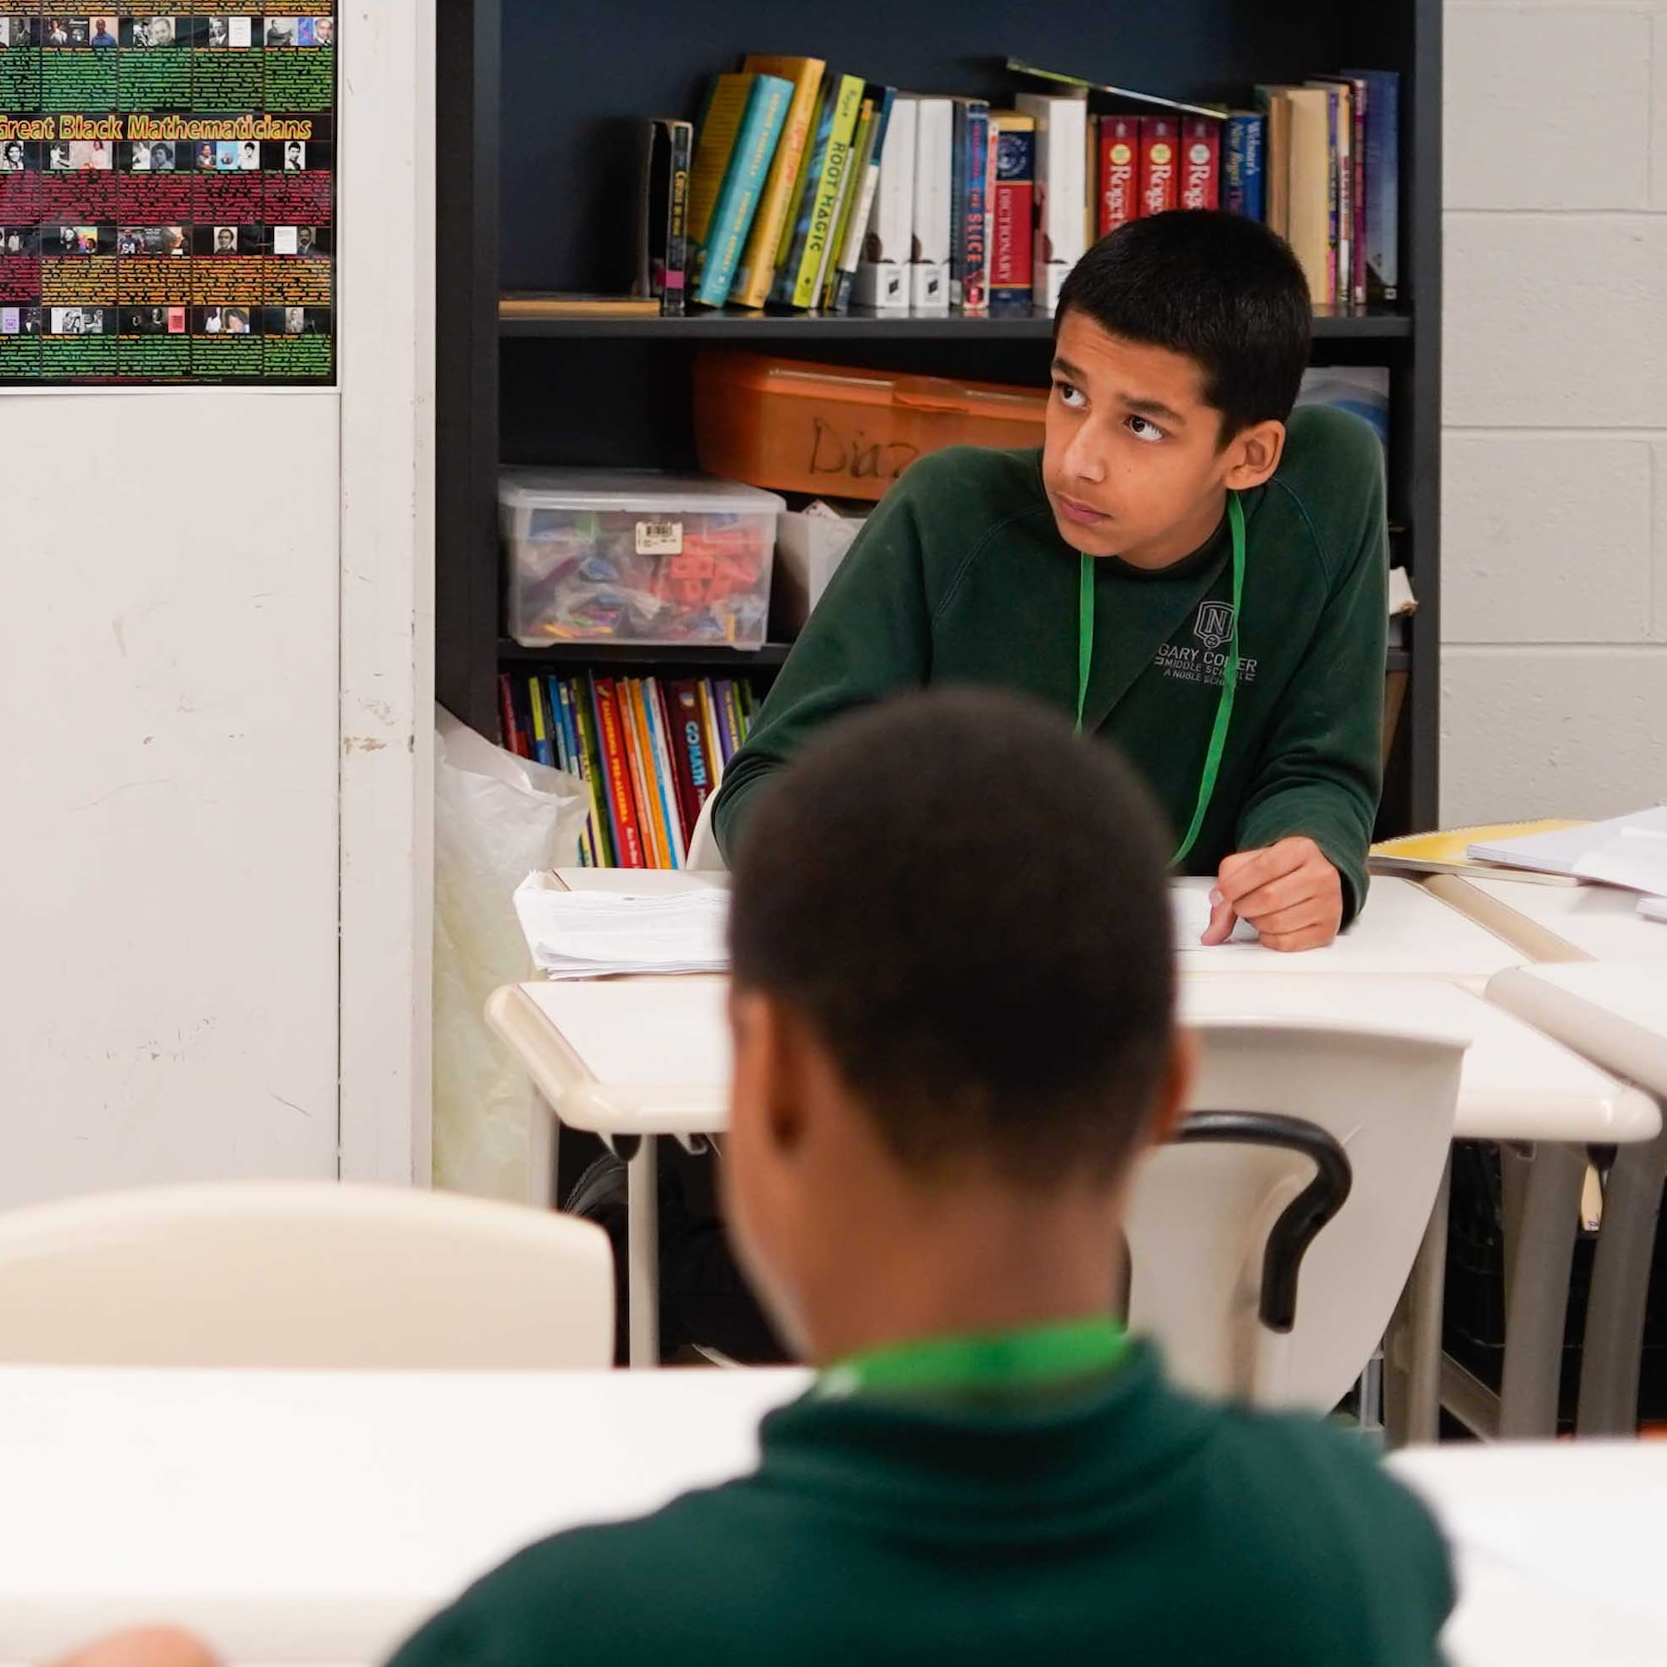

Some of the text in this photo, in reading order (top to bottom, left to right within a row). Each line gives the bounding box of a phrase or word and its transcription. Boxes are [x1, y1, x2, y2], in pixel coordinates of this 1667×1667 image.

[58, 114, 123, 140] Black
[127, 114, 313, 141] Mathematicians
[809, 141, 847, 252] ROOT MAGIC
